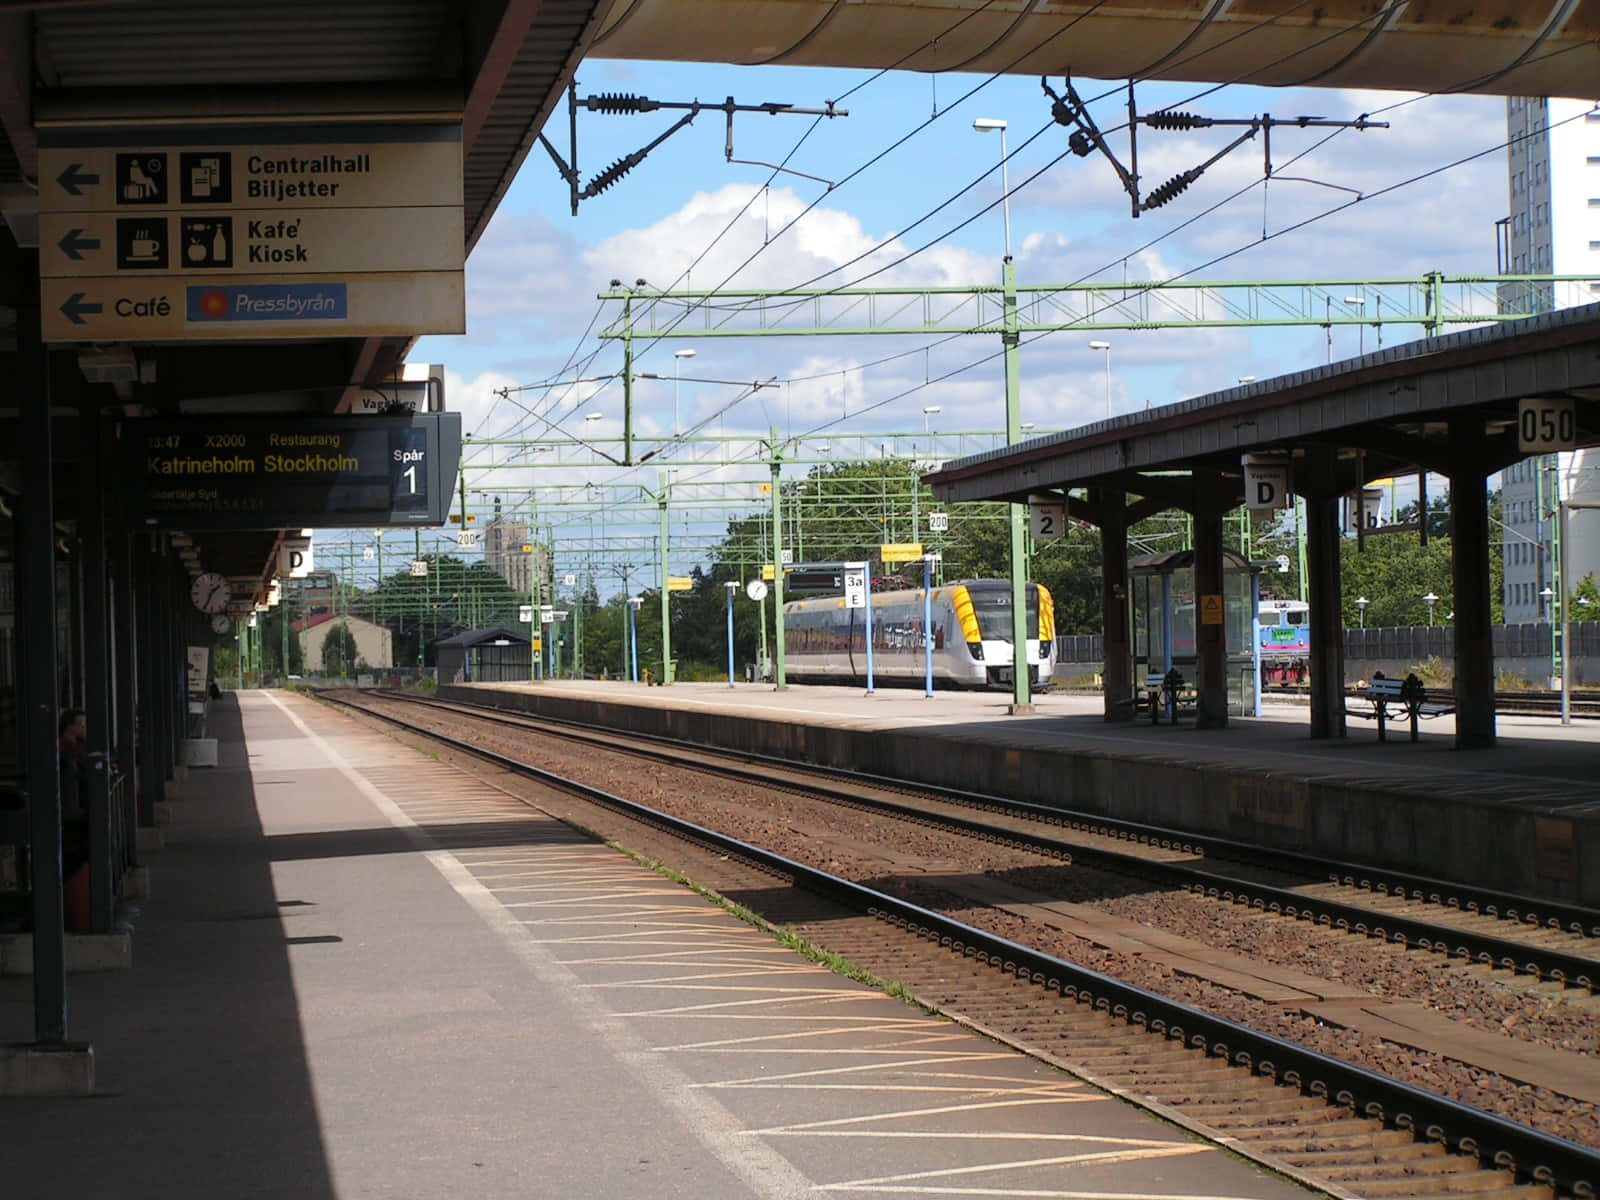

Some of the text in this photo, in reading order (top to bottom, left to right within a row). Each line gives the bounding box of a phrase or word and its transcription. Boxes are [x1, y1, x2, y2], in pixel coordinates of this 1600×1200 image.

[247, 155, 370, 174] Centralhall
[247, 180, 339, 201] Biljetter
[248, 244, 308, 263] Kiosk
[115, 296, 171, 318] Café
[235, 292, 336, 316] Pressbyrån
[1523, 409, 1573, 442] 050
[205, 433, 246, 448] X2000
[270, 433, 341, 449] Restaurang
[147, 454, 359, 473] Katrineholm Stockholm
[393, 449, 424, 464] Spår
[403, 466, 416, 493] 1
[1258, 482, 1274, 505] D
[931, 516, 947, 528] 200
[1040, 516, 1053, 534] 2
[458, 534, 475, 545] 200
[290, 551, 303, 568] D
[848, 576, 863, 587] 3a
[852, 595, 859, 605] E
